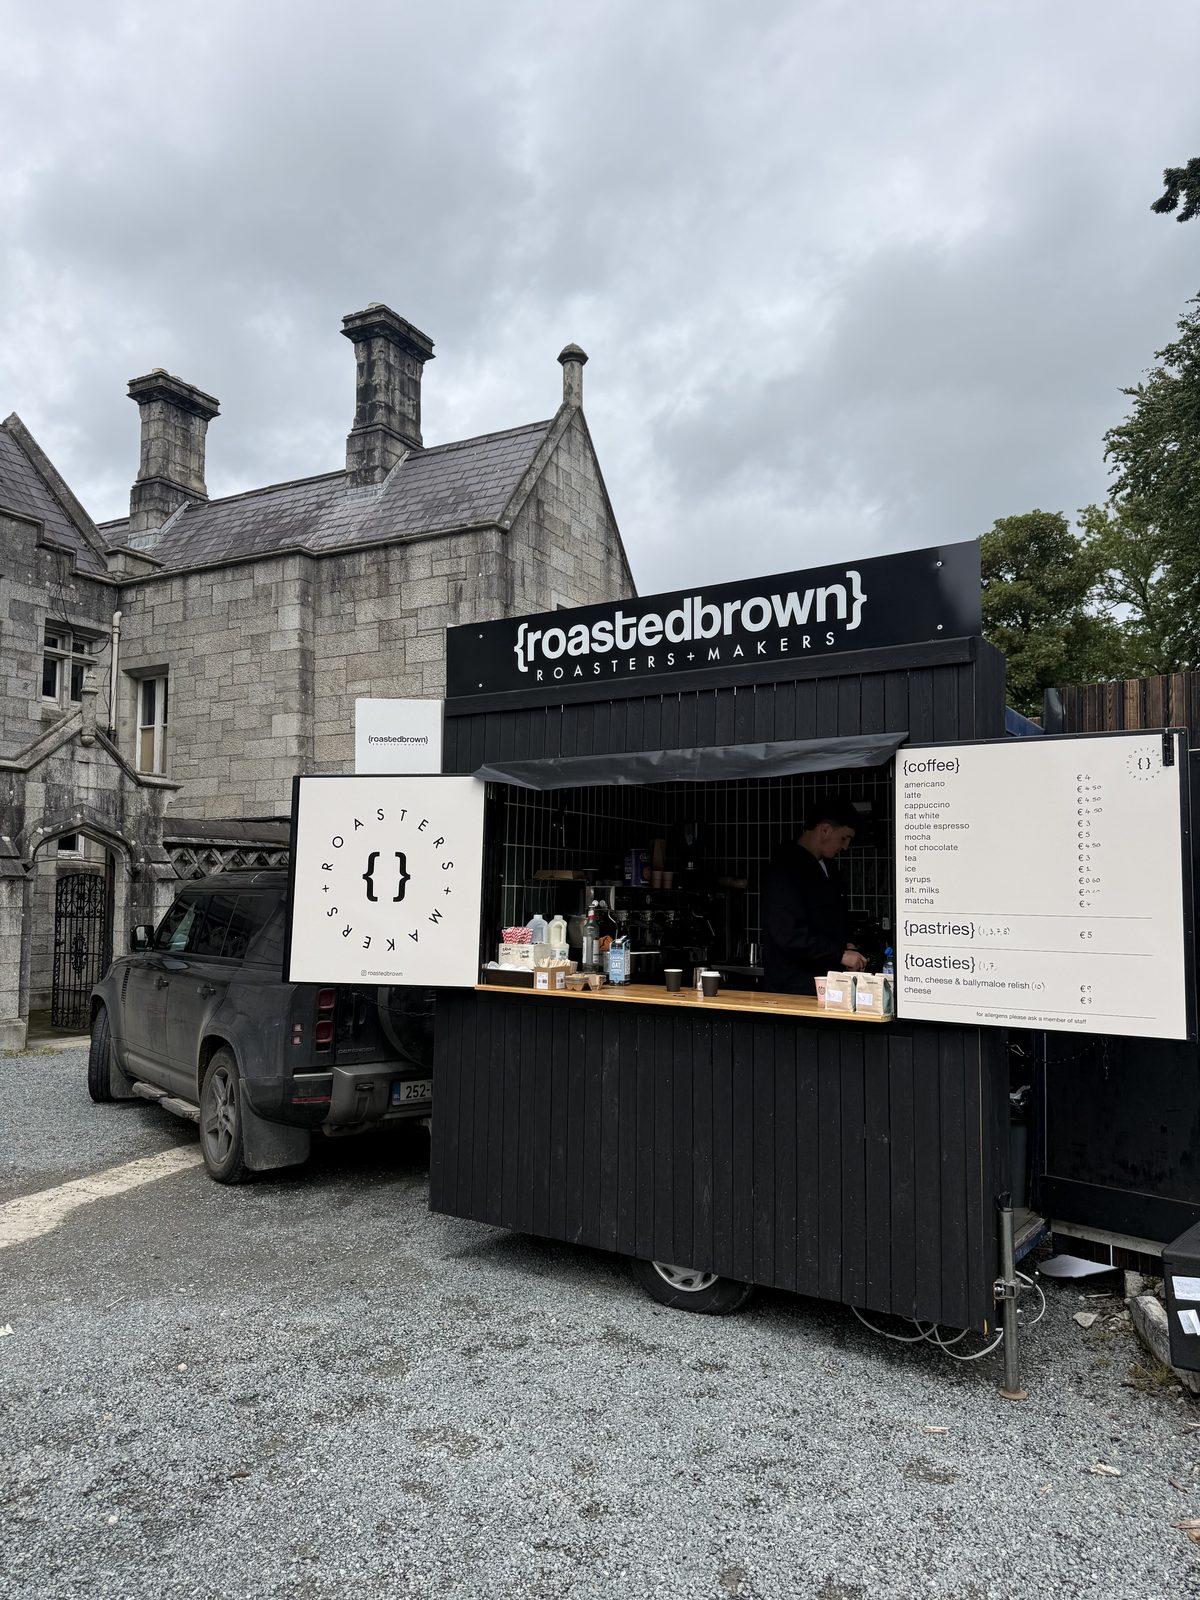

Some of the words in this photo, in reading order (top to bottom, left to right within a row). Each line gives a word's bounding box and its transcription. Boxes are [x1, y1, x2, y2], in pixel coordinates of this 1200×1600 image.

[514, 570, 867, 673] {roastedbrown}
[903, 758, 960, 776] {coffee}
[904, 802, 950, 810] cappuccino
[934, 822, 970, 830] espresso
[904, 920, 975, 938] {pastries}
[904, 953, 976, 974] {toasties}
[904, 975, 922, 983] ham,
[925, 976, 952, 985] cheese
[962, 978, 1006, 988] ballymaloe
[1008, 982, 1030, 990] relish
